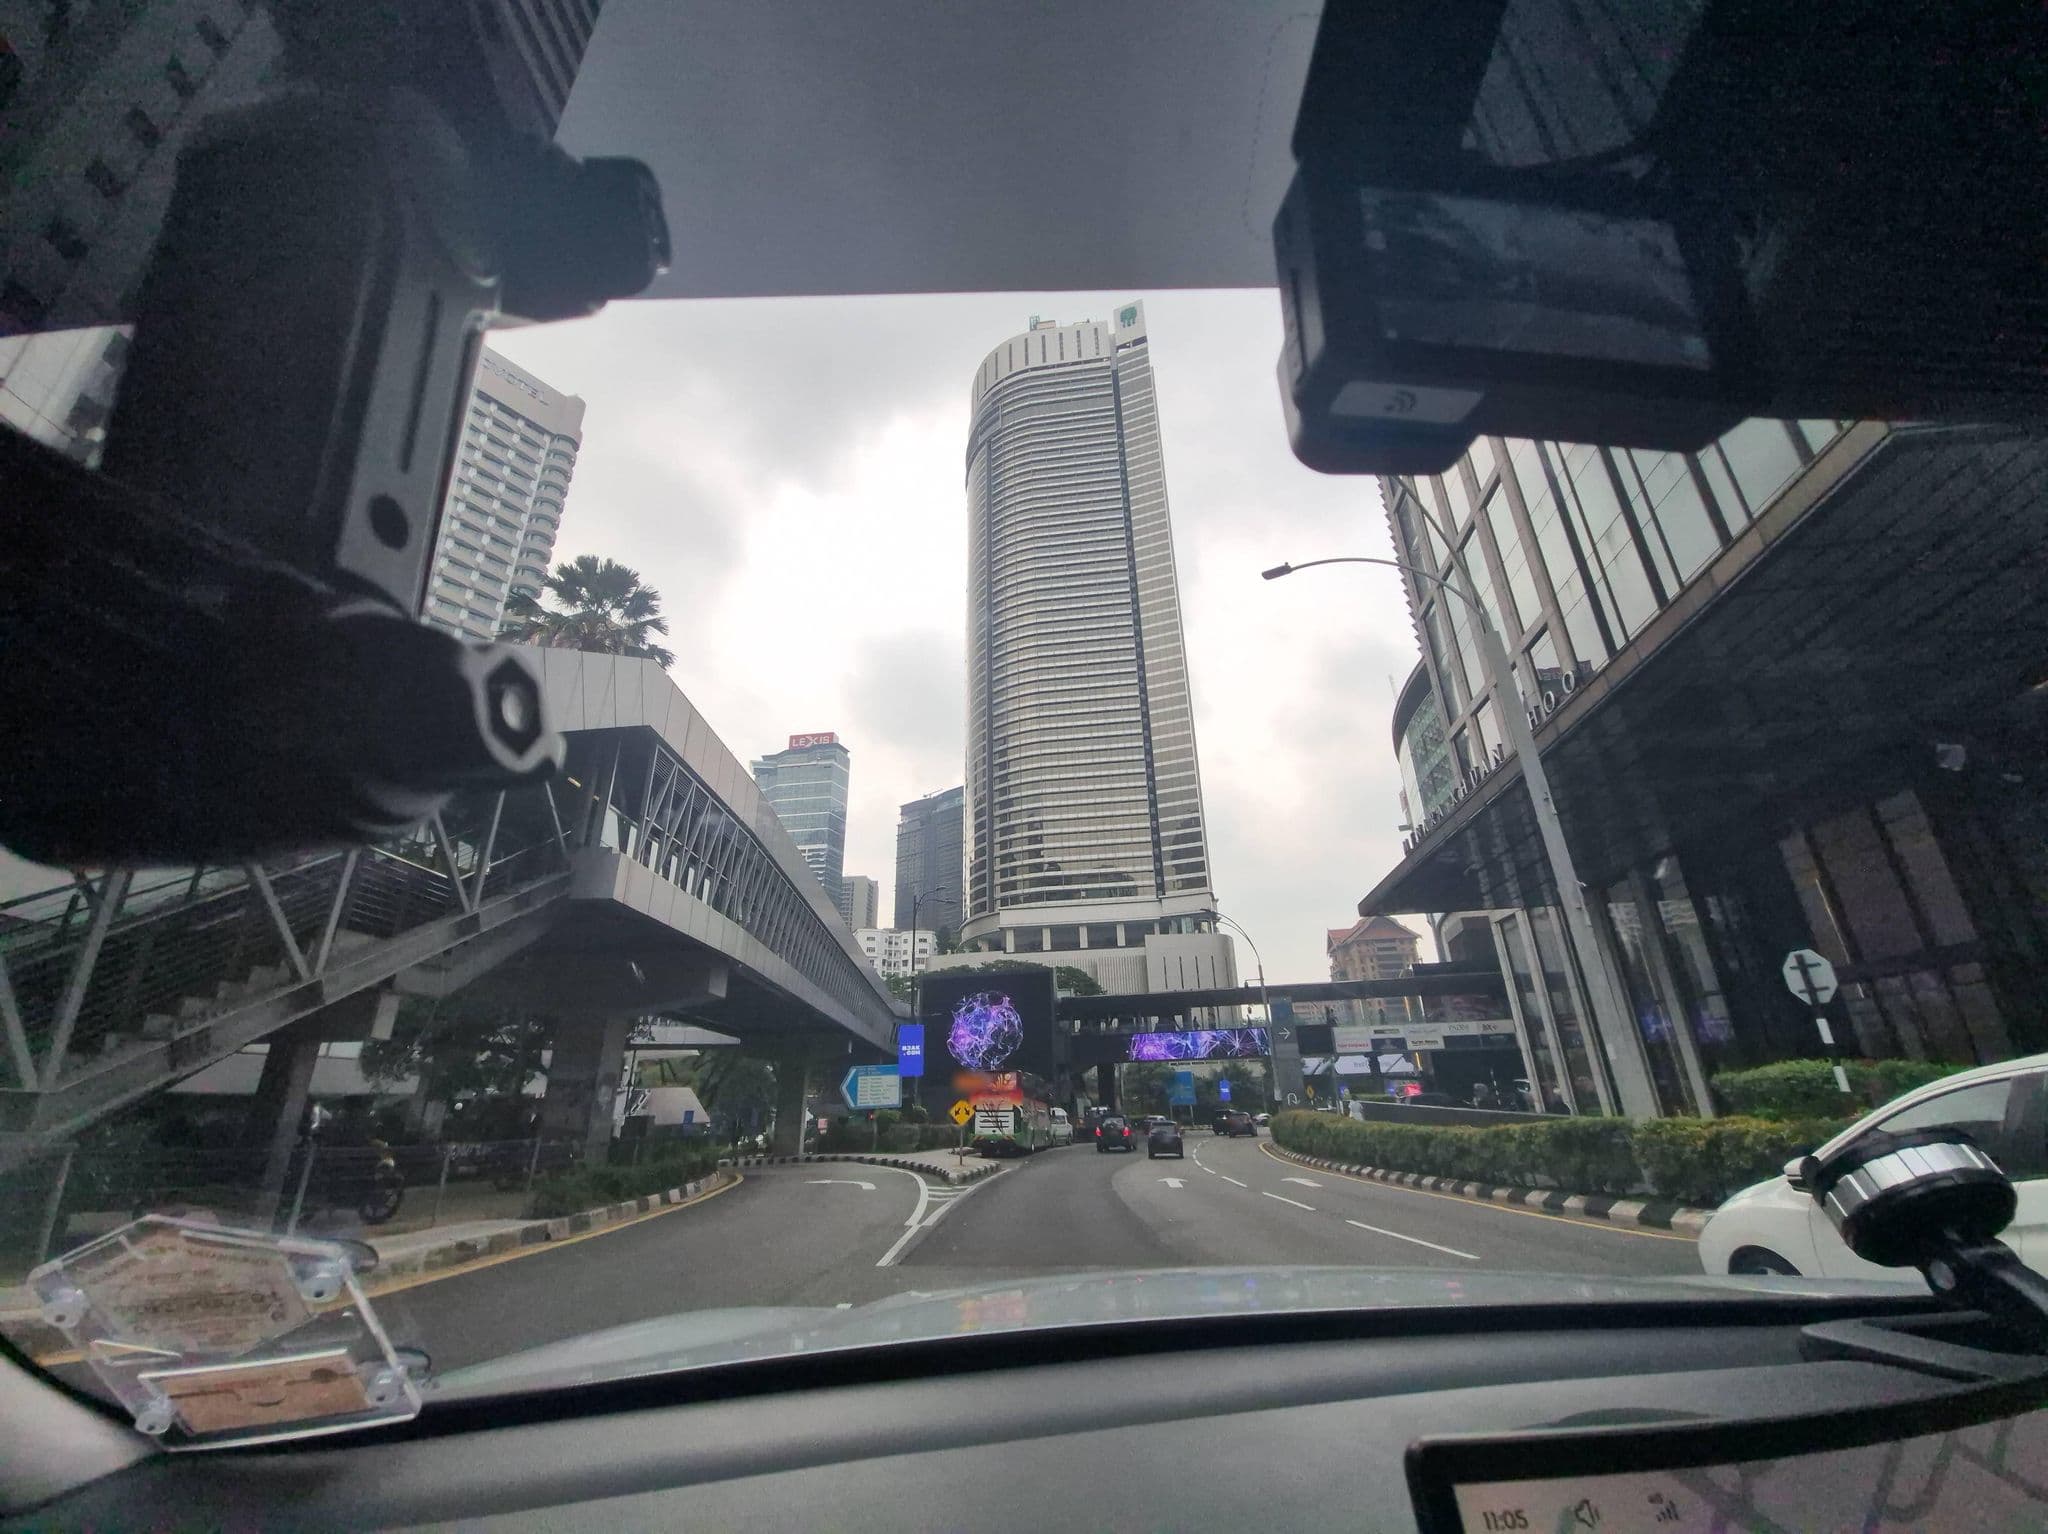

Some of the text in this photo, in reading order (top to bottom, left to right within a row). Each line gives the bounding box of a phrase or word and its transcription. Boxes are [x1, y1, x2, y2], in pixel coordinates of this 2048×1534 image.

[1526, 670, 1575, 730] HOO
[792, 735, 830, 748] LEXIS
[1482, 1509, 1529, 1531] 11:05
